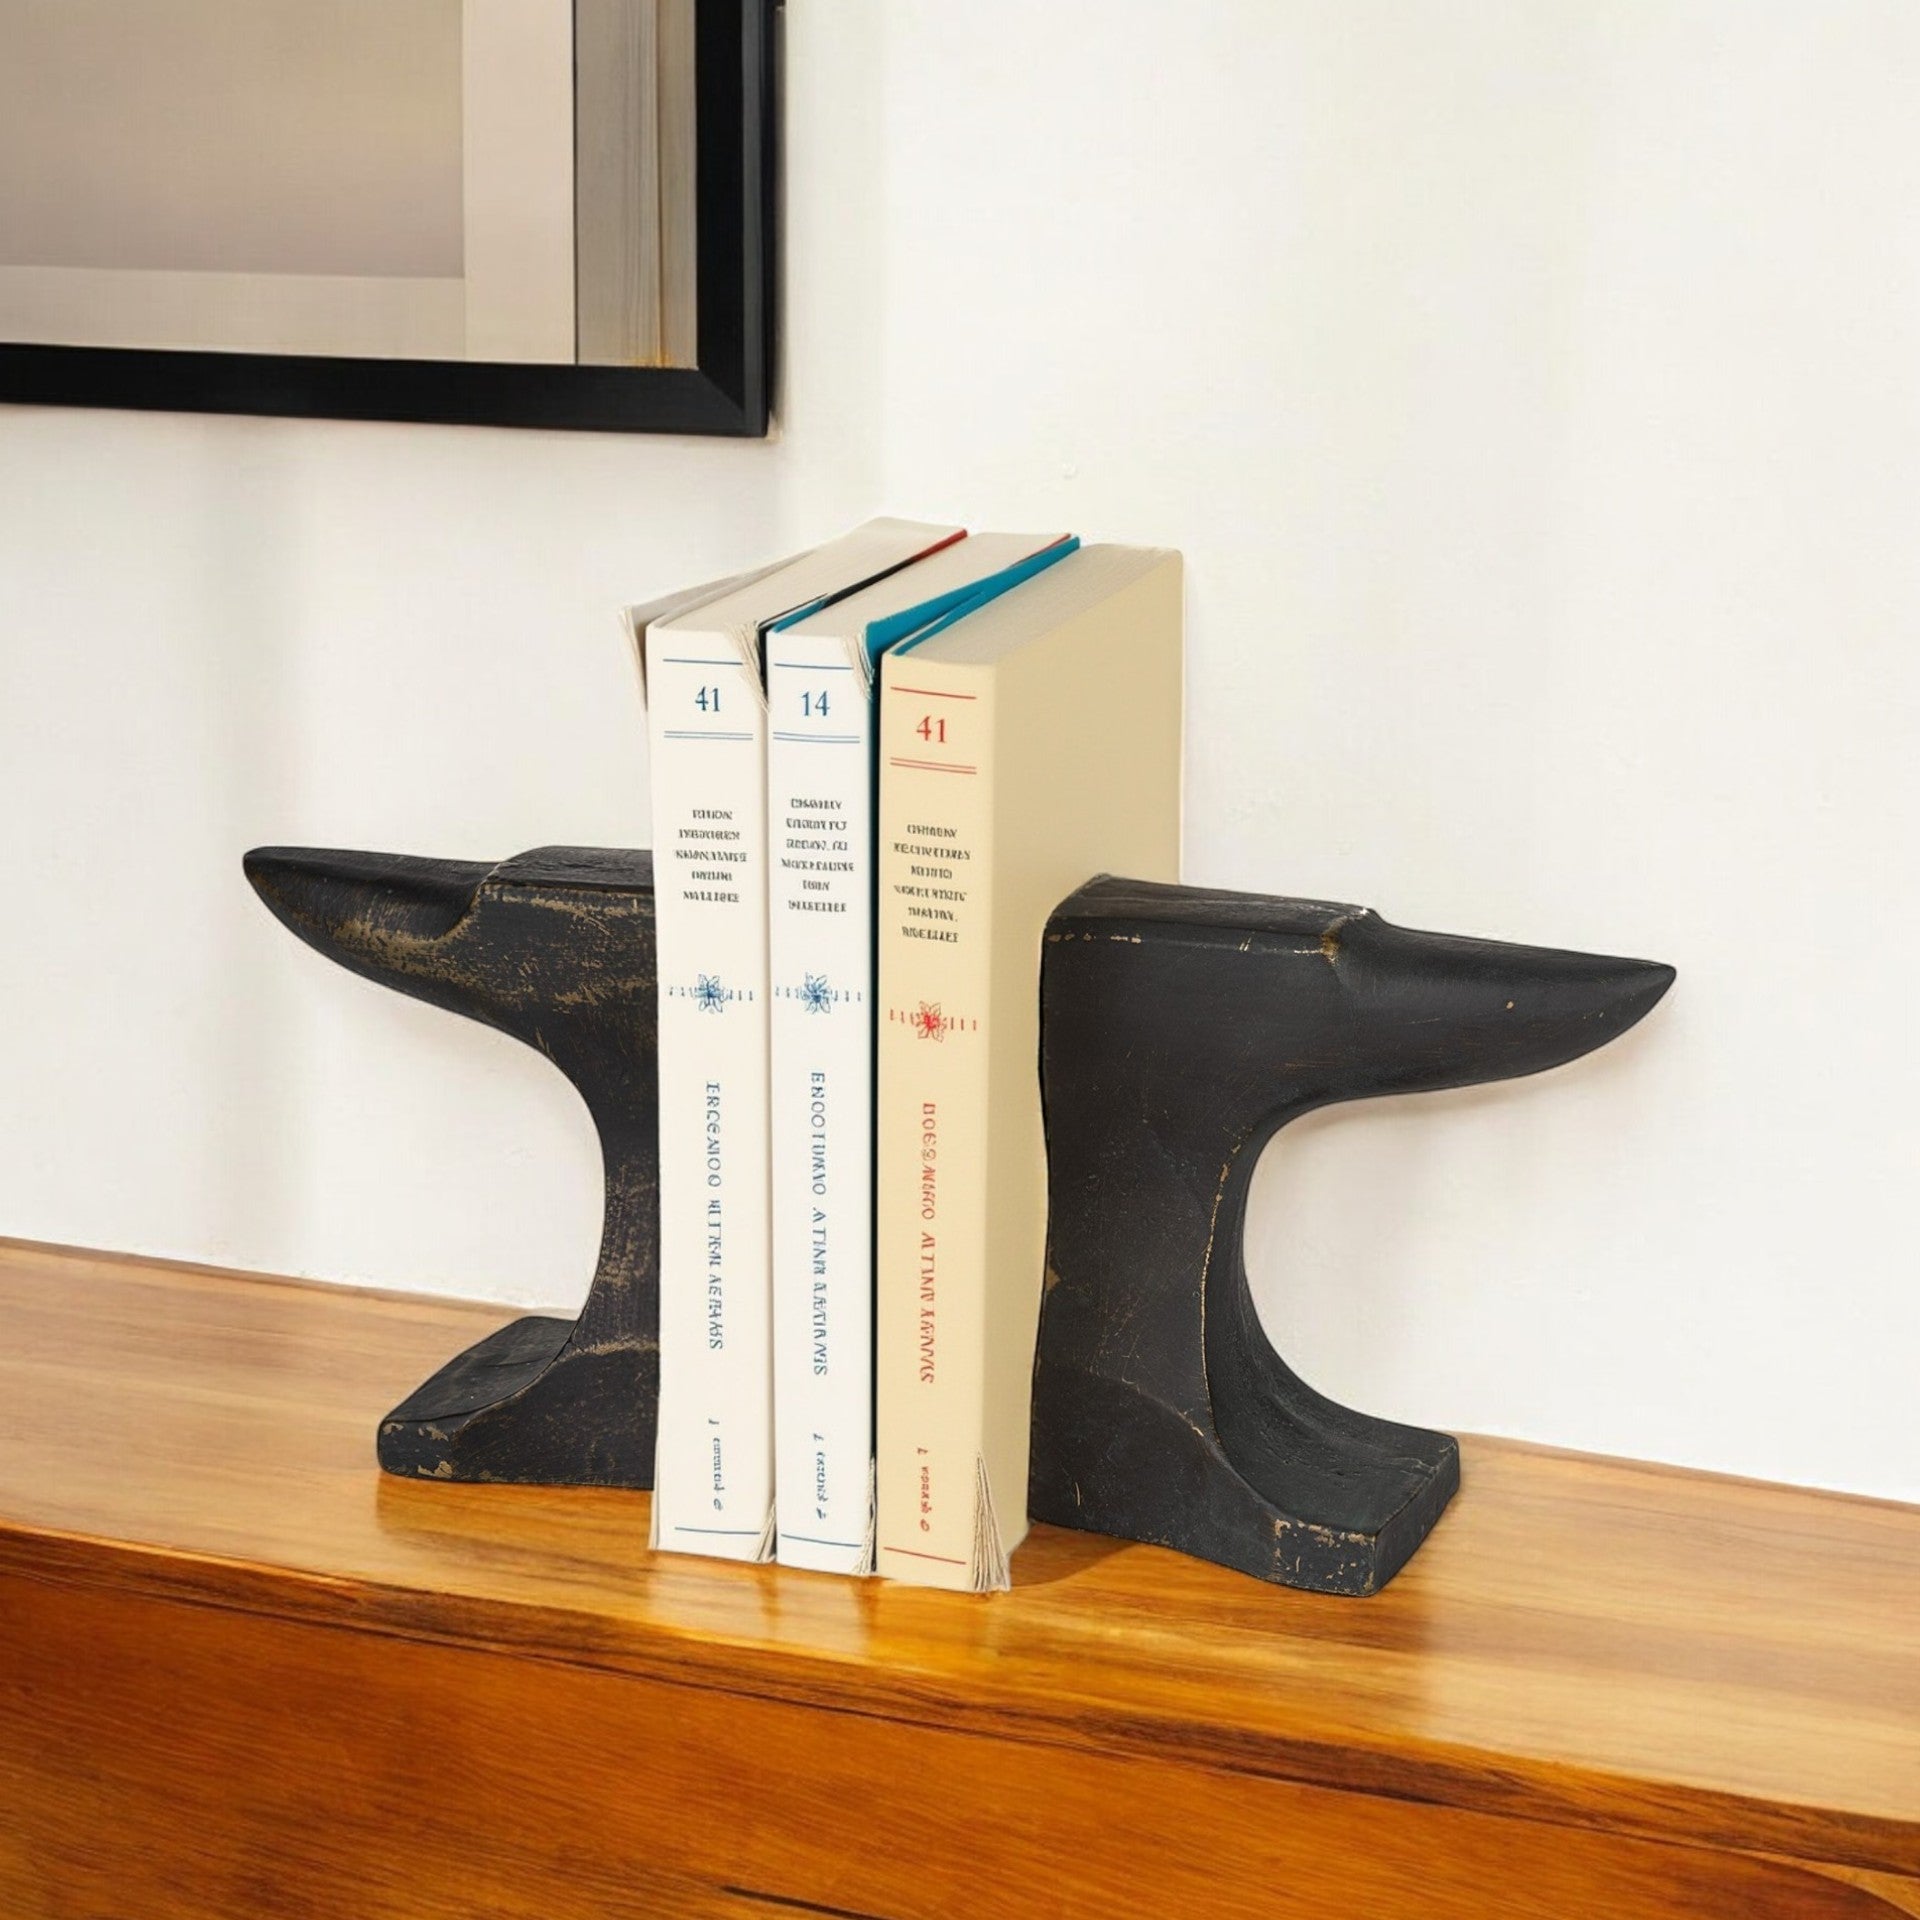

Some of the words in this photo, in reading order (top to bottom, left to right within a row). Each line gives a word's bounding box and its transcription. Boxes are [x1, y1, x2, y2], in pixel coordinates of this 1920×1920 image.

[694, 686, 722, 712] 41
[801, 690, 831, 717] 14
[916, 715, 946, 744] 41
